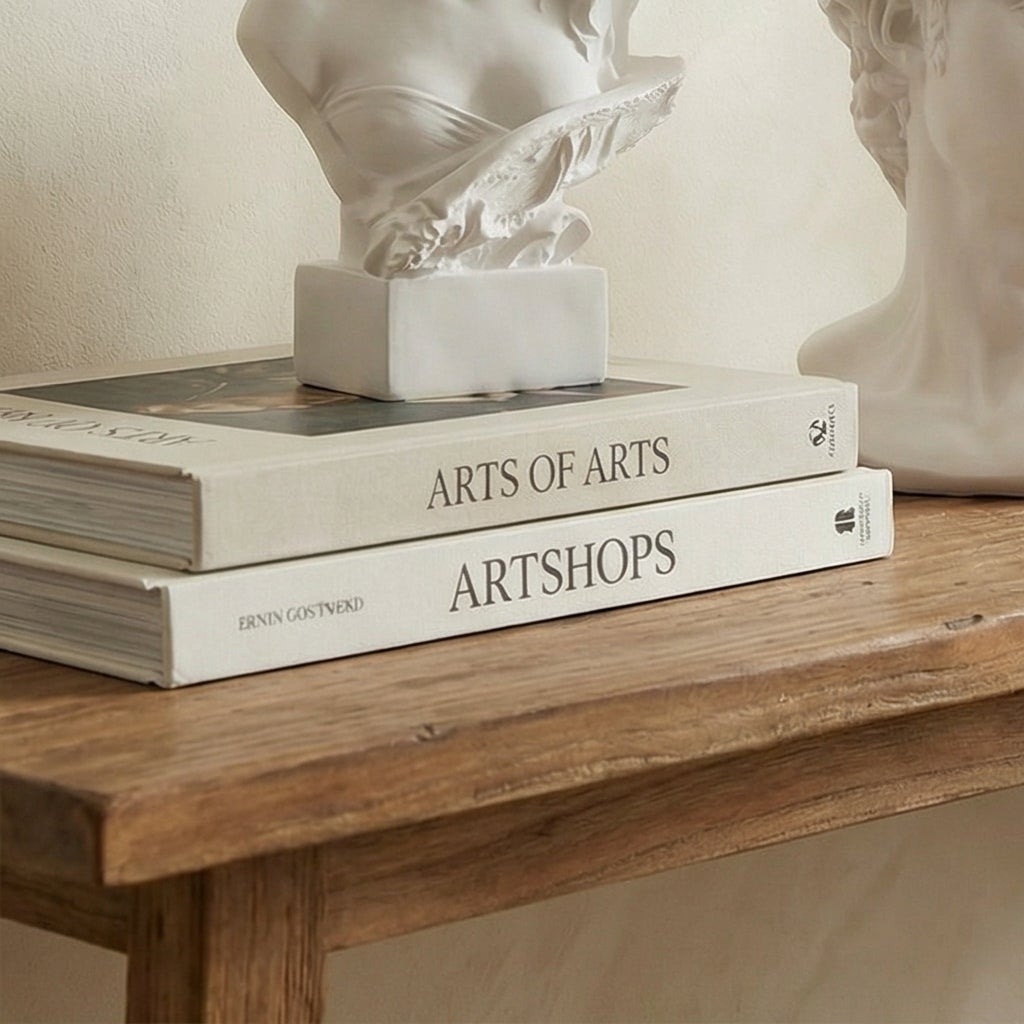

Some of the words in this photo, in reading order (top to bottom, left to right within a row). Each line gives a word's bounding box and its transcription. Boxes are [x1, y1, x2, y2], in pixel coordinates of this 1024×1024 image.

[426, 457, 520, 511] ARTS
[528, 450, 577, 494] OF
[582, 436, 672, 487] ARTS
[448, 529, 678, 613] ARTSHOPS
